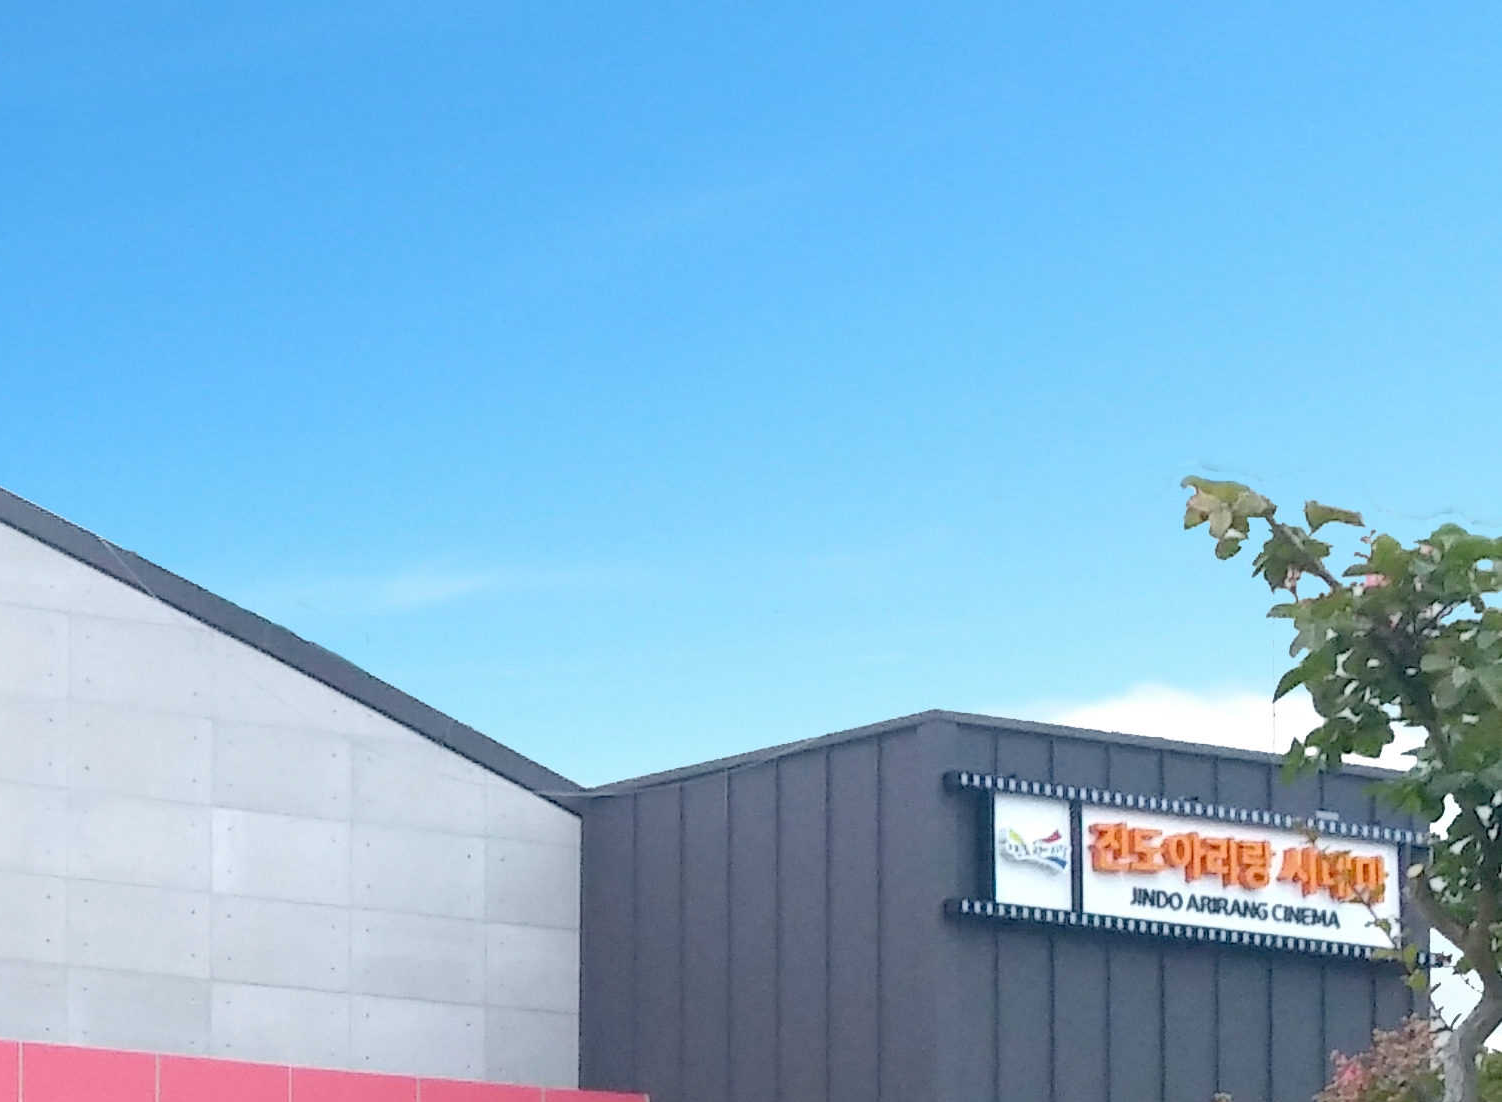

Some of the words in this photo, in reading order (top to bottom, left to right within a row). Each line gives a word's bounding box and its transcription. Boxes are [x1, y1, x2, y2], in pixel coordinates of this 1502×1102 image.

[1089, 822, 1272, 889] 진도아리랑
[1130, 886, 1183, 910] JINDO
[1186, 894, 1268, 921] ARIRANG
[1271, 903, 1341, 929] CINEMA
